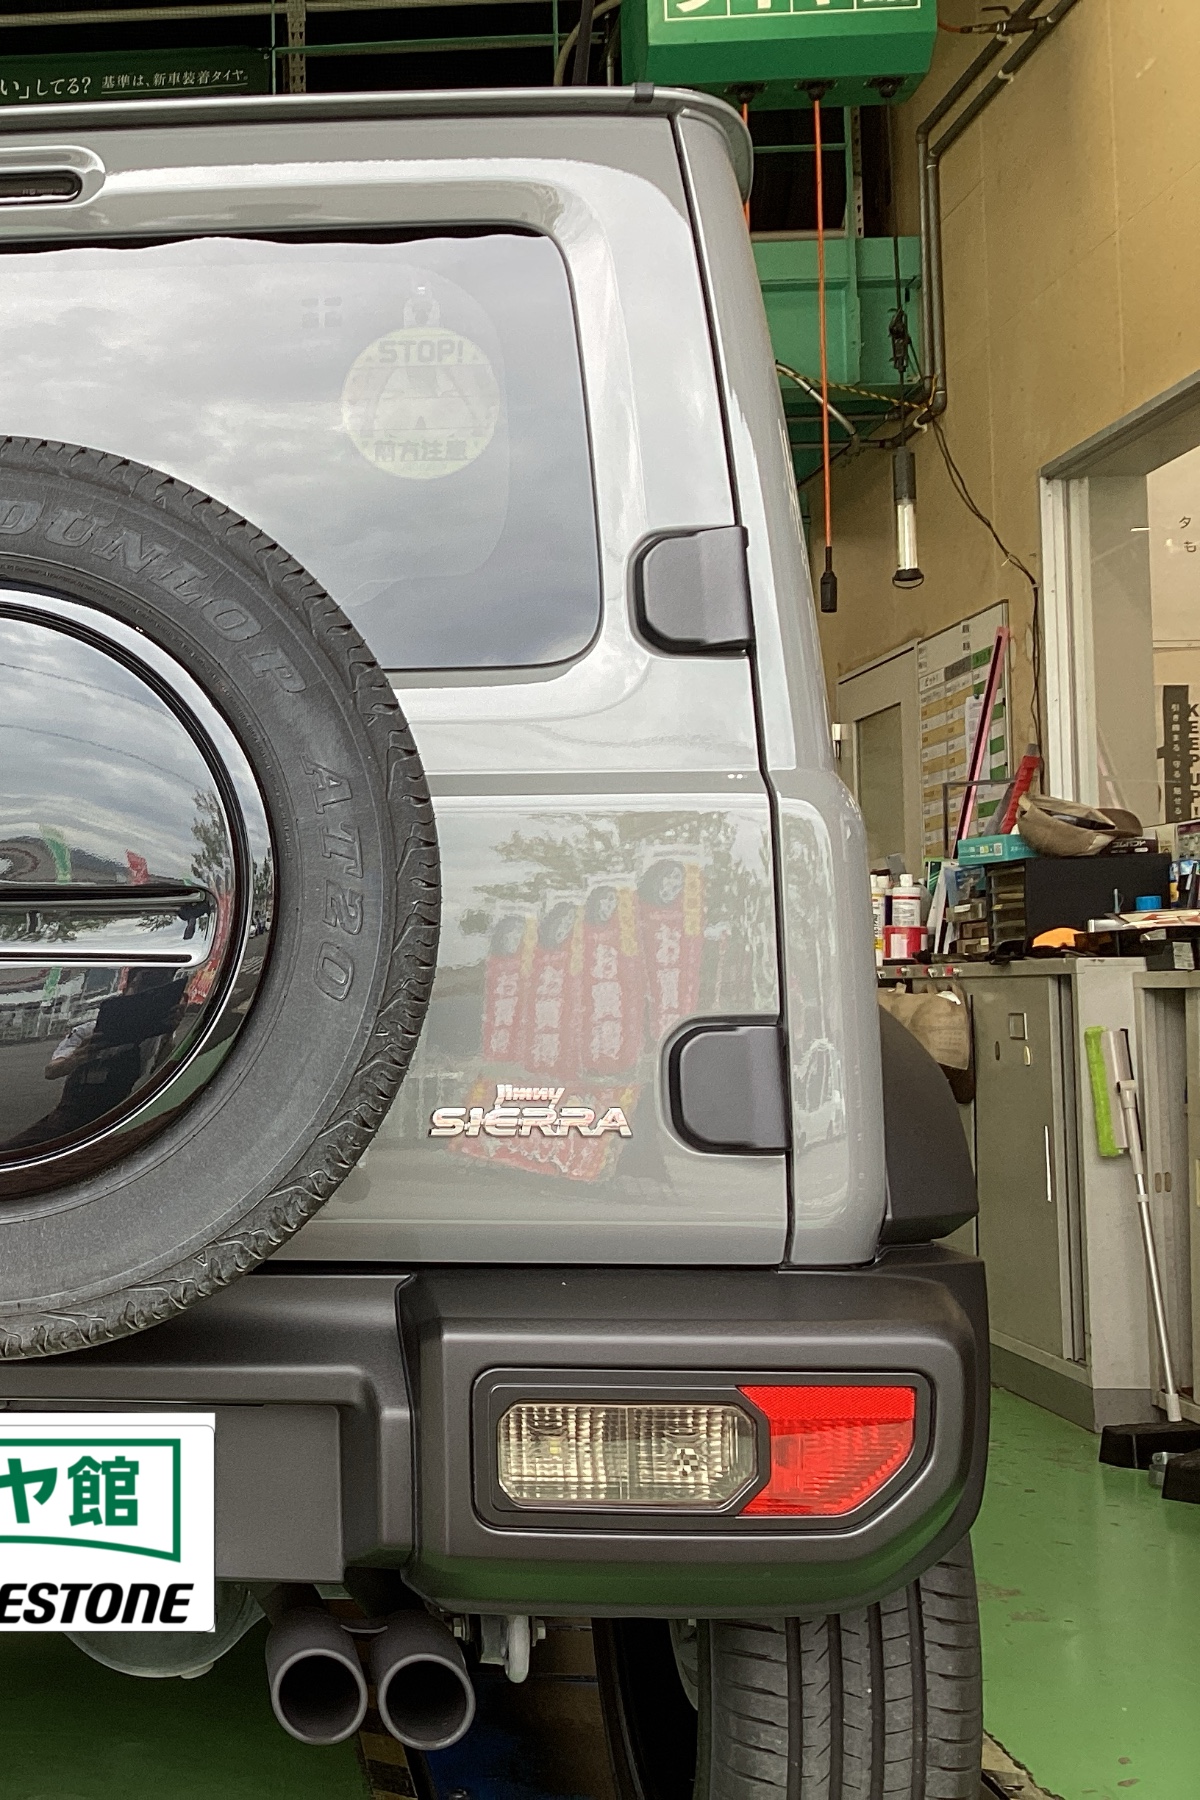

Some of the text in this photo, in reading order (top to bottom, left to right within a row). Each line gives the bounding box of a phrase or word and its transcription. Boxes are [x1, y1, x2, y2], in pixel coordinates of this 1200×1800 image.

[378, 340, 464, 364] STOP!
[302, 755, 363, 1000] AT20
[429, 1107, 633, 1137] SIERRA
